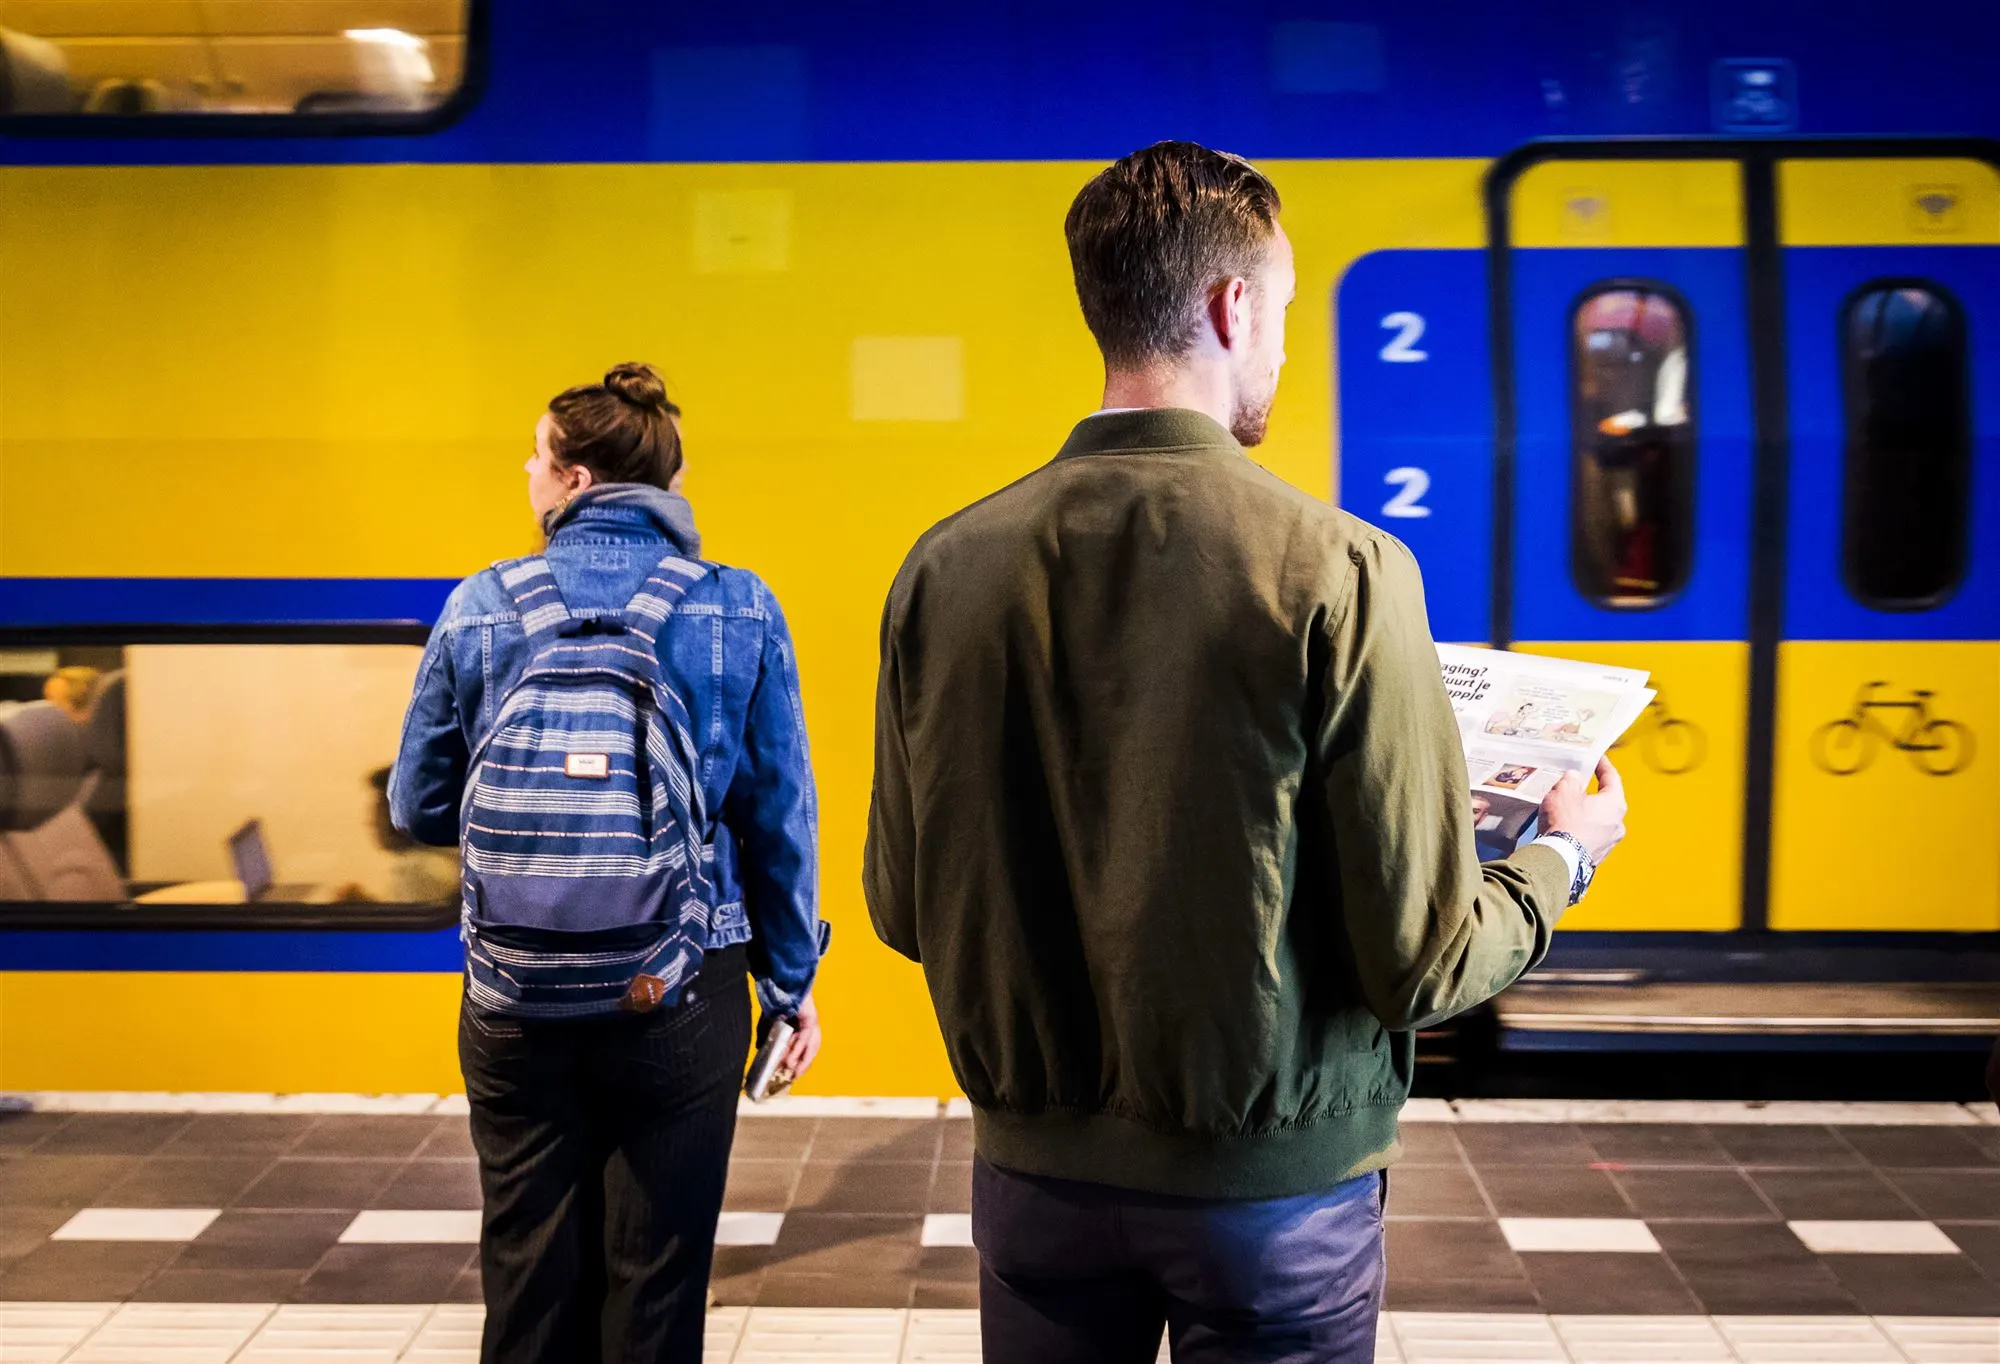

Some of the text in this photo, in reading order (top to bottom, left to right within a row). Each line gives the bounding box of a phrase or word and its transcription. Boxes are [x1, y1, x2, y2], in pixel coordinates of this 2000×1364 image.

[1380, 311, 1428, 363] 2
[1381, 467, 1432, 518] 2
[1473, 679, 1491, 693] je
